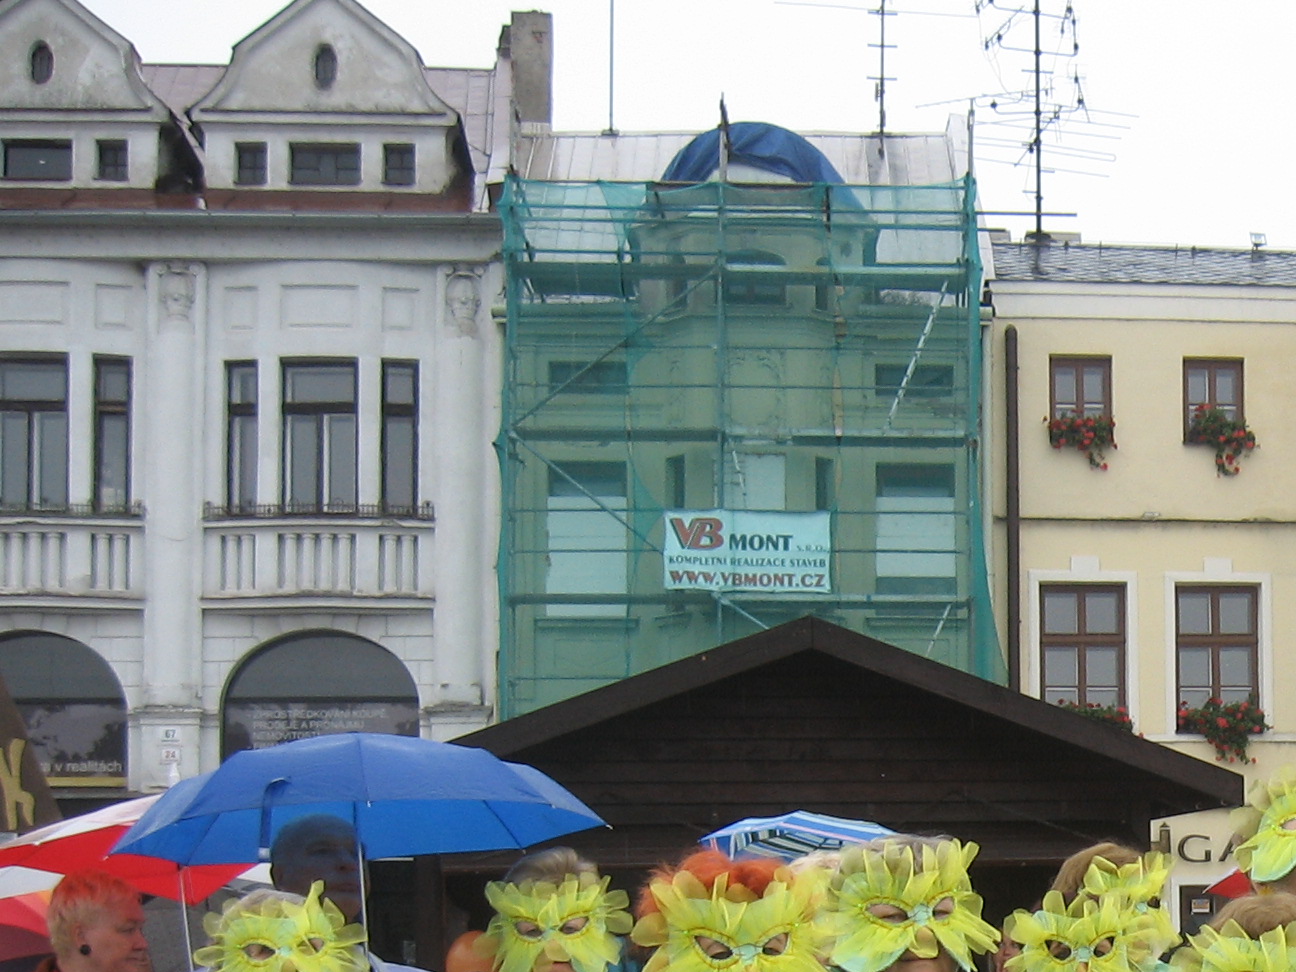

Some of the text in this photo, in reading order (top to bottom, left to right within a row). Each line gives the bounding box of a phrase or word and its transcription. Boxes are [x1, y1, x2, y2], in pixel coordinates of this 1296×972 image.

[669, 517, 725, 549] VB
[729, 533, 793, 551] MONT
[730, 557, 786, 567] REALIZACE
[790, 558, 826, 567] STAVEB
[669, 570, 826, 588] WWW.VBMONT.CZ
[253, 720, 298, 729] PRODEJE
[300, 721, 308, 729] A
[165, 729, 176, 738] 67
[66, 760, 122, 772] realitách
